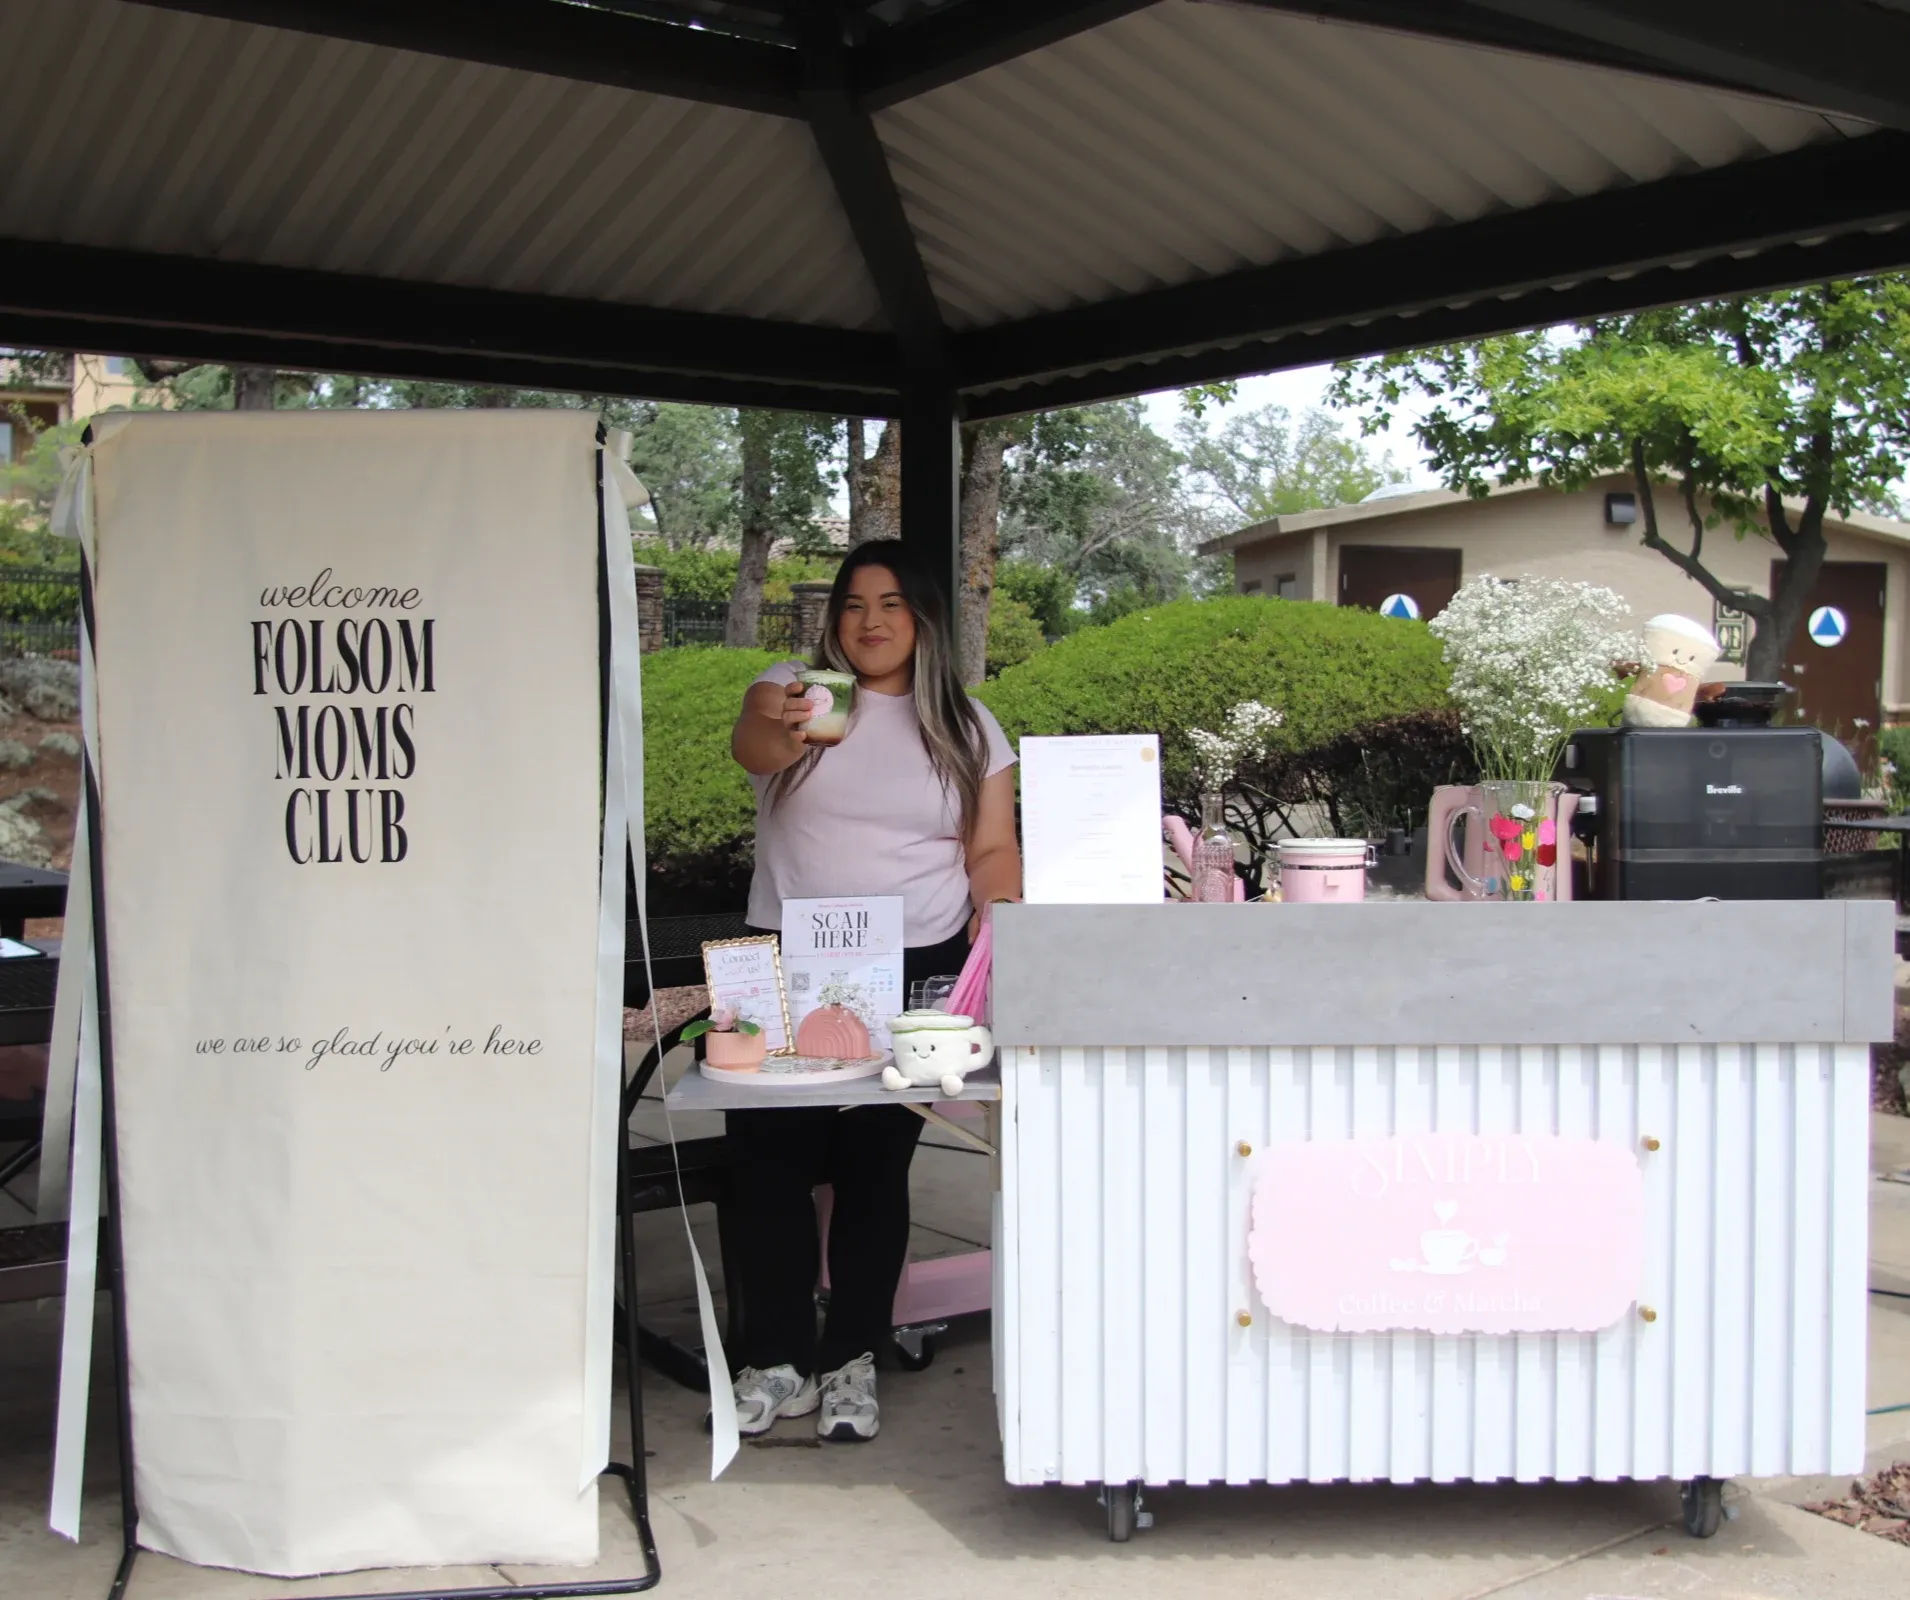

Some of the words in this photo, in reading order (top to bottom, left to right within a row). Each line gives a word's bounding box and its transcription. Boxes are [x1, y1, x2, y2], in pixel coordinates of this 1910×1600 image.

[260, 568, 423, 610] welcome
[251, 618, 436, 695] FOLSOM
[274, 703, 416, 781] MOMS
[1706, 784, 1742, 794] Breville
[285, 788, 408, 865] CLUB
[812, 911, 868, 930] SCAN
[814, 930, 867, 948] HERE
[195, 1037, 226, 1054] we
[233, 1036, 271, 1053] are
[275, 1035, 303, 1053] so
[304, 1026, 383, 1071] glad
[380, 1025, 476, 1073] you're
[482, 1024, 544, 1056] here
[1350, 1138, 1542, 1199] SIMPLY
